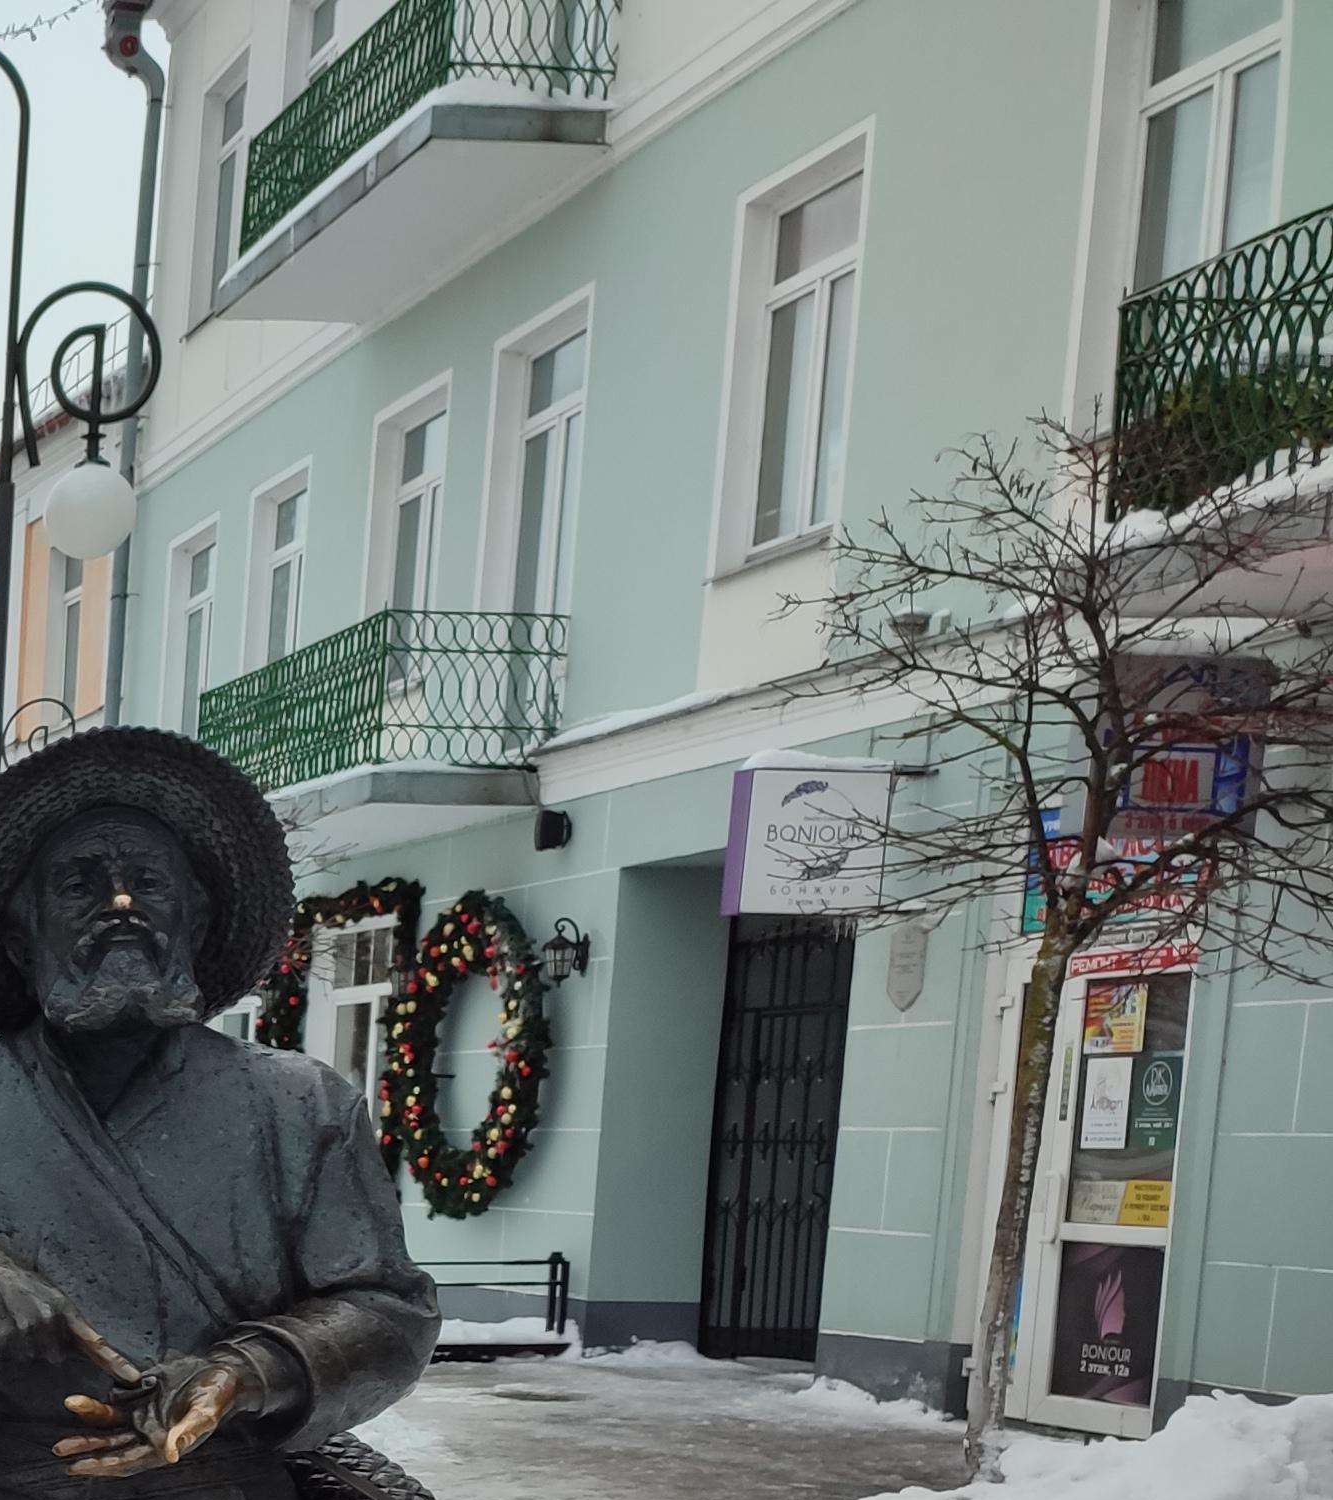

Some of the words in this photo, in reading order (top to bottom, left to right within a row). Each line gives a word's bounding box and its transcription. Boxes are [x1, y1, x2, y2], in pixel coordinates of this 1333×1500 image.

[766, 823, 863, 843] BONJOUR
[769, 885, 851, 896] БОНЖУР
[1079, 1359, 1087, 1372] 2
